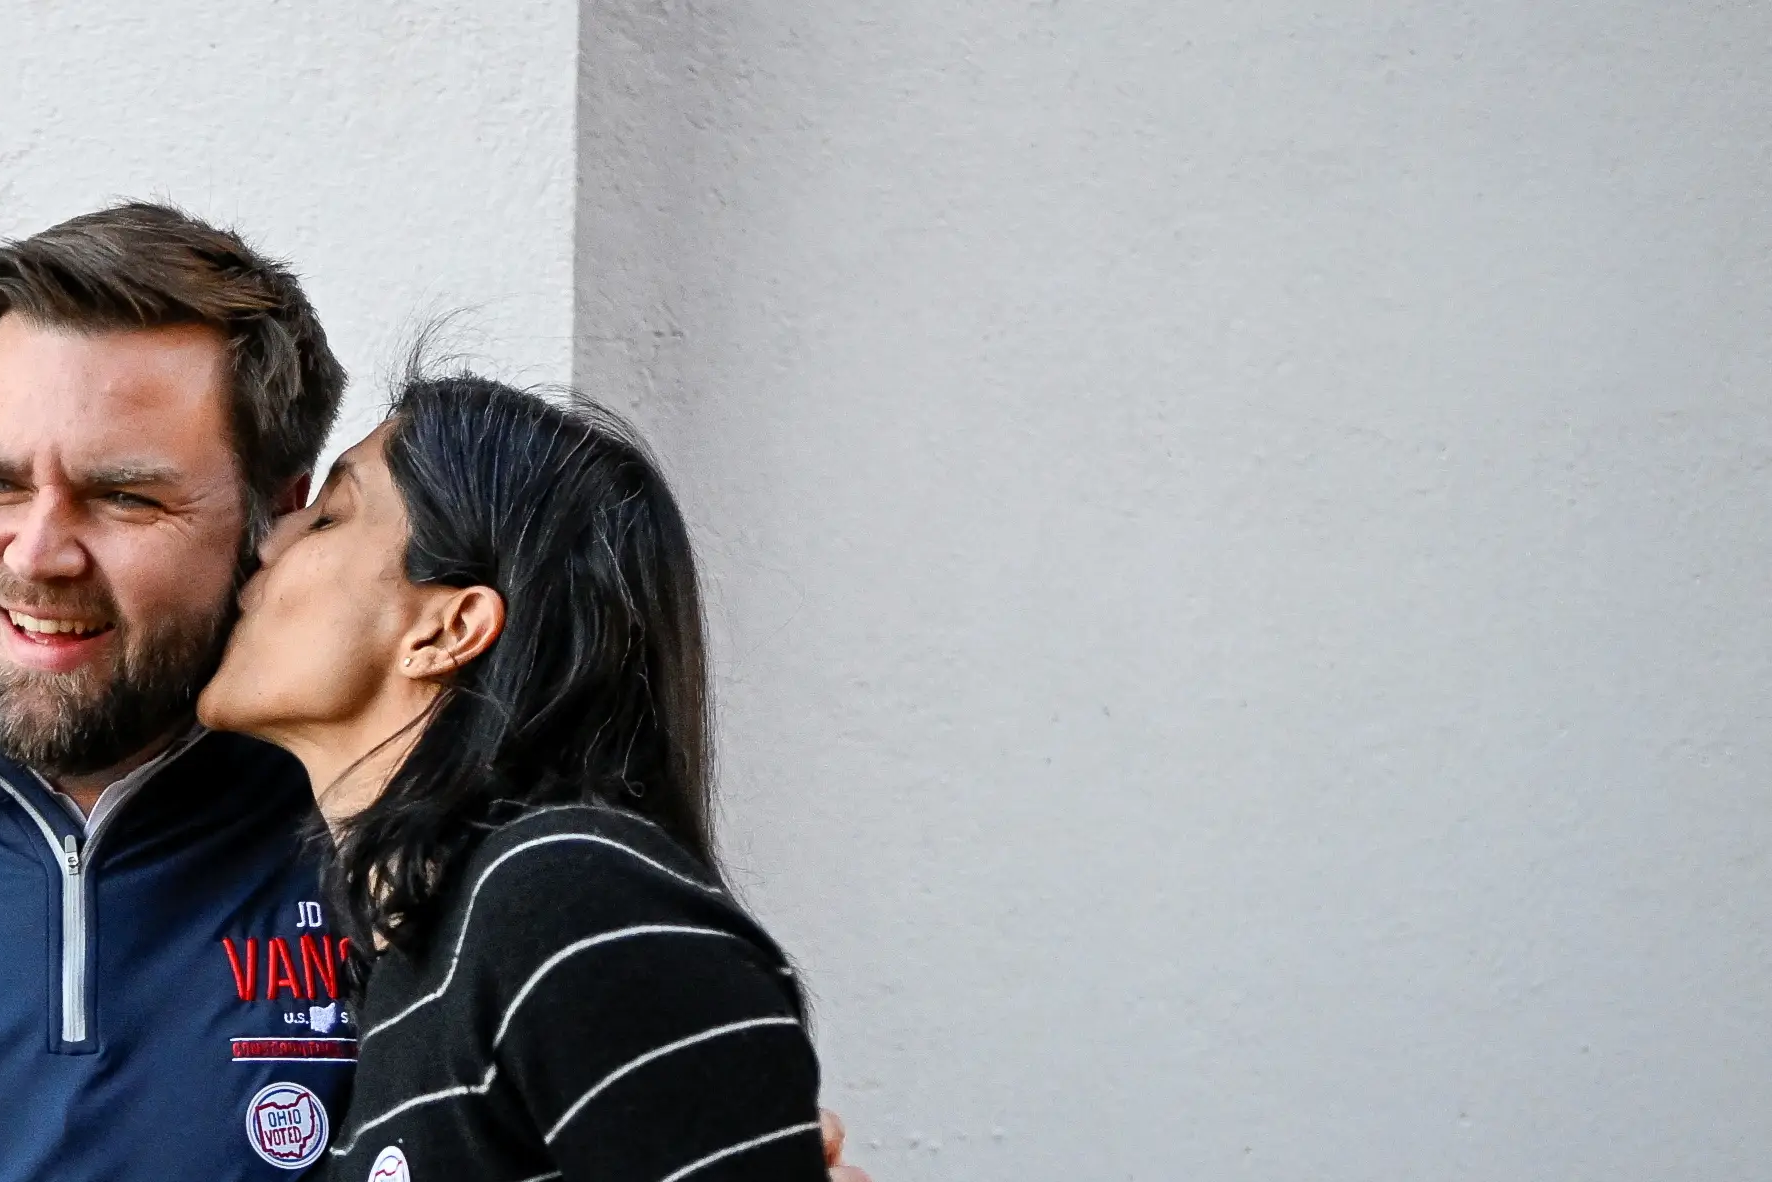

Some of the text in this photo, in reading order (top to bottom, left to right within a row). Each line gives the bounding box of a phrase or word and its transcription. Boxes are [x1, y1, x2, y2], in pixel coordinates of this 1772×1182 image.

[296, 901, 323, 928] JD
[283, 1012, 309, 1024] U.S.
[268, 1109, 302, 1127] OHIO
[264, 1126, 302, 1146] VOTED
